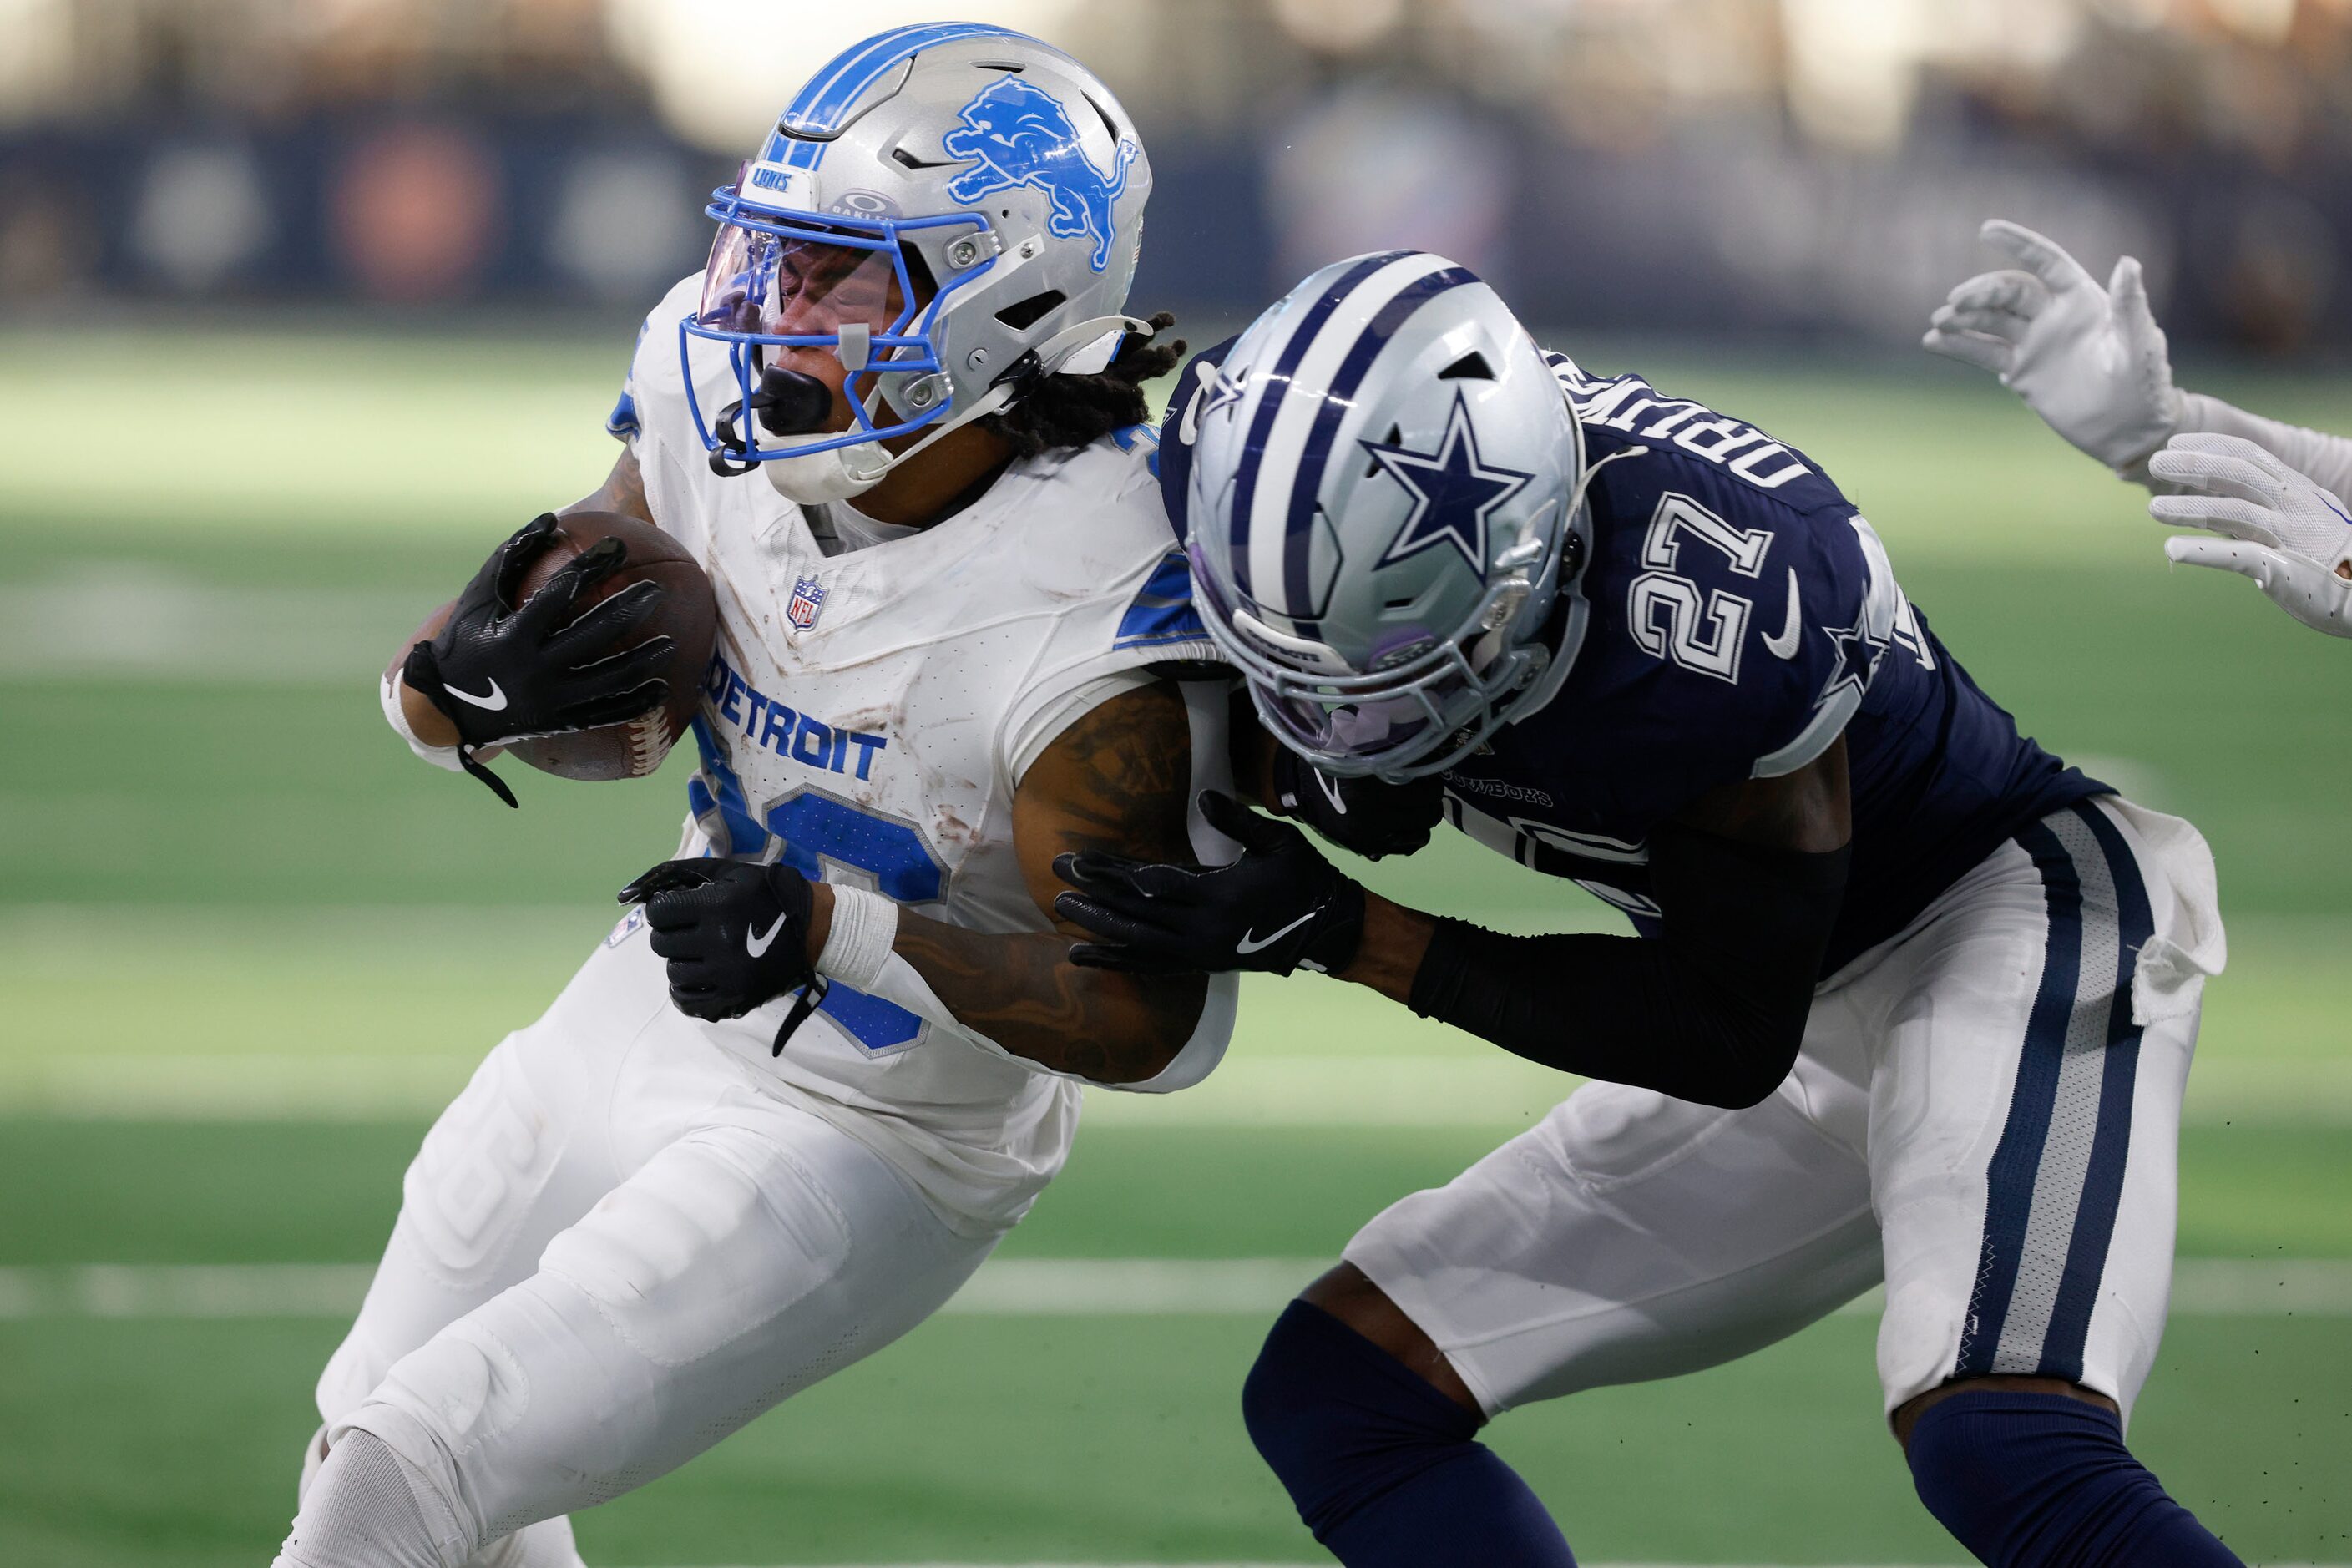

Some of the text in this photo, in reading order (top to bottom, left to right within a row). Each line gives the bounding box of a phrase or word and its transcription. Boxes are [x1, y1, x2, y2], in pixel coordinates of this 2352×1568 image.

[790, 597, 815, 625] NFL
[1627, 491, 1775, 685] 27
[706, 647, 888, 782] DETROIT
